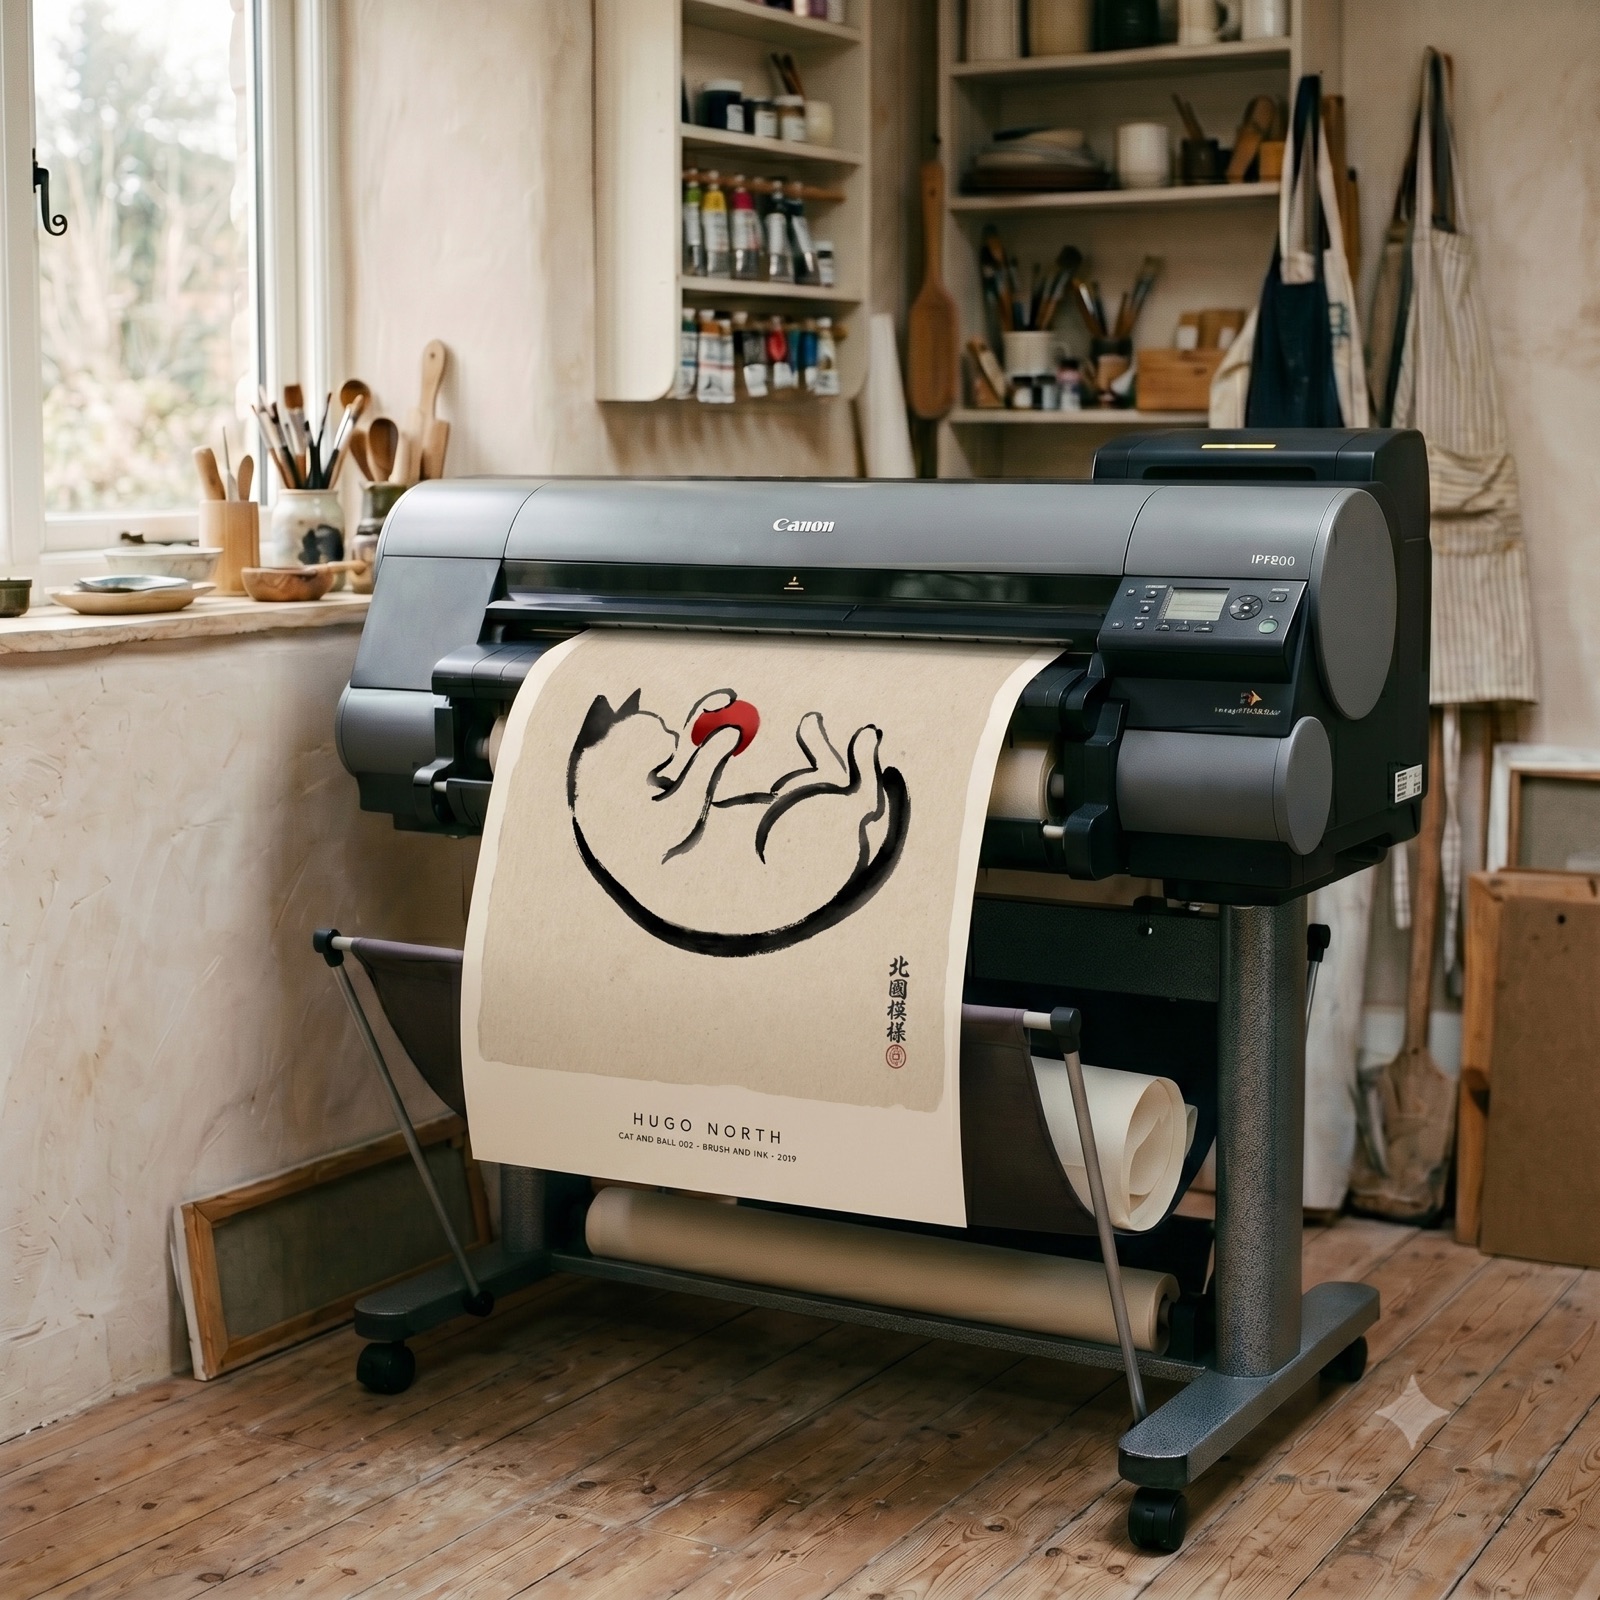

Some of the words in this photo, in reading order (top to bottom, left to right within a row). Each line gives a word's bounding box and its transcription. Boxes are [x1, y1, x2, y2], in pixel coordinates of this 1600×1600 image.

[772, 517, 835, 532] Canon
[633, 1112, 692, 1133] HUGO
[707, 1122, 781, 1144] NORTH
[618, 1131, 634, 1141] CAT
[635, 1134, 654, 1143] AND
[656, 1136, 676, 1147] BALL
[678, 1139, 694, 1149] 002
[702, 1143, 730, 1154] BRUSH
[732, 1147, 751, 1157] AND
[753, 1150, 769, 1159] INK
[777, 1153, 797, 1163] 2019
